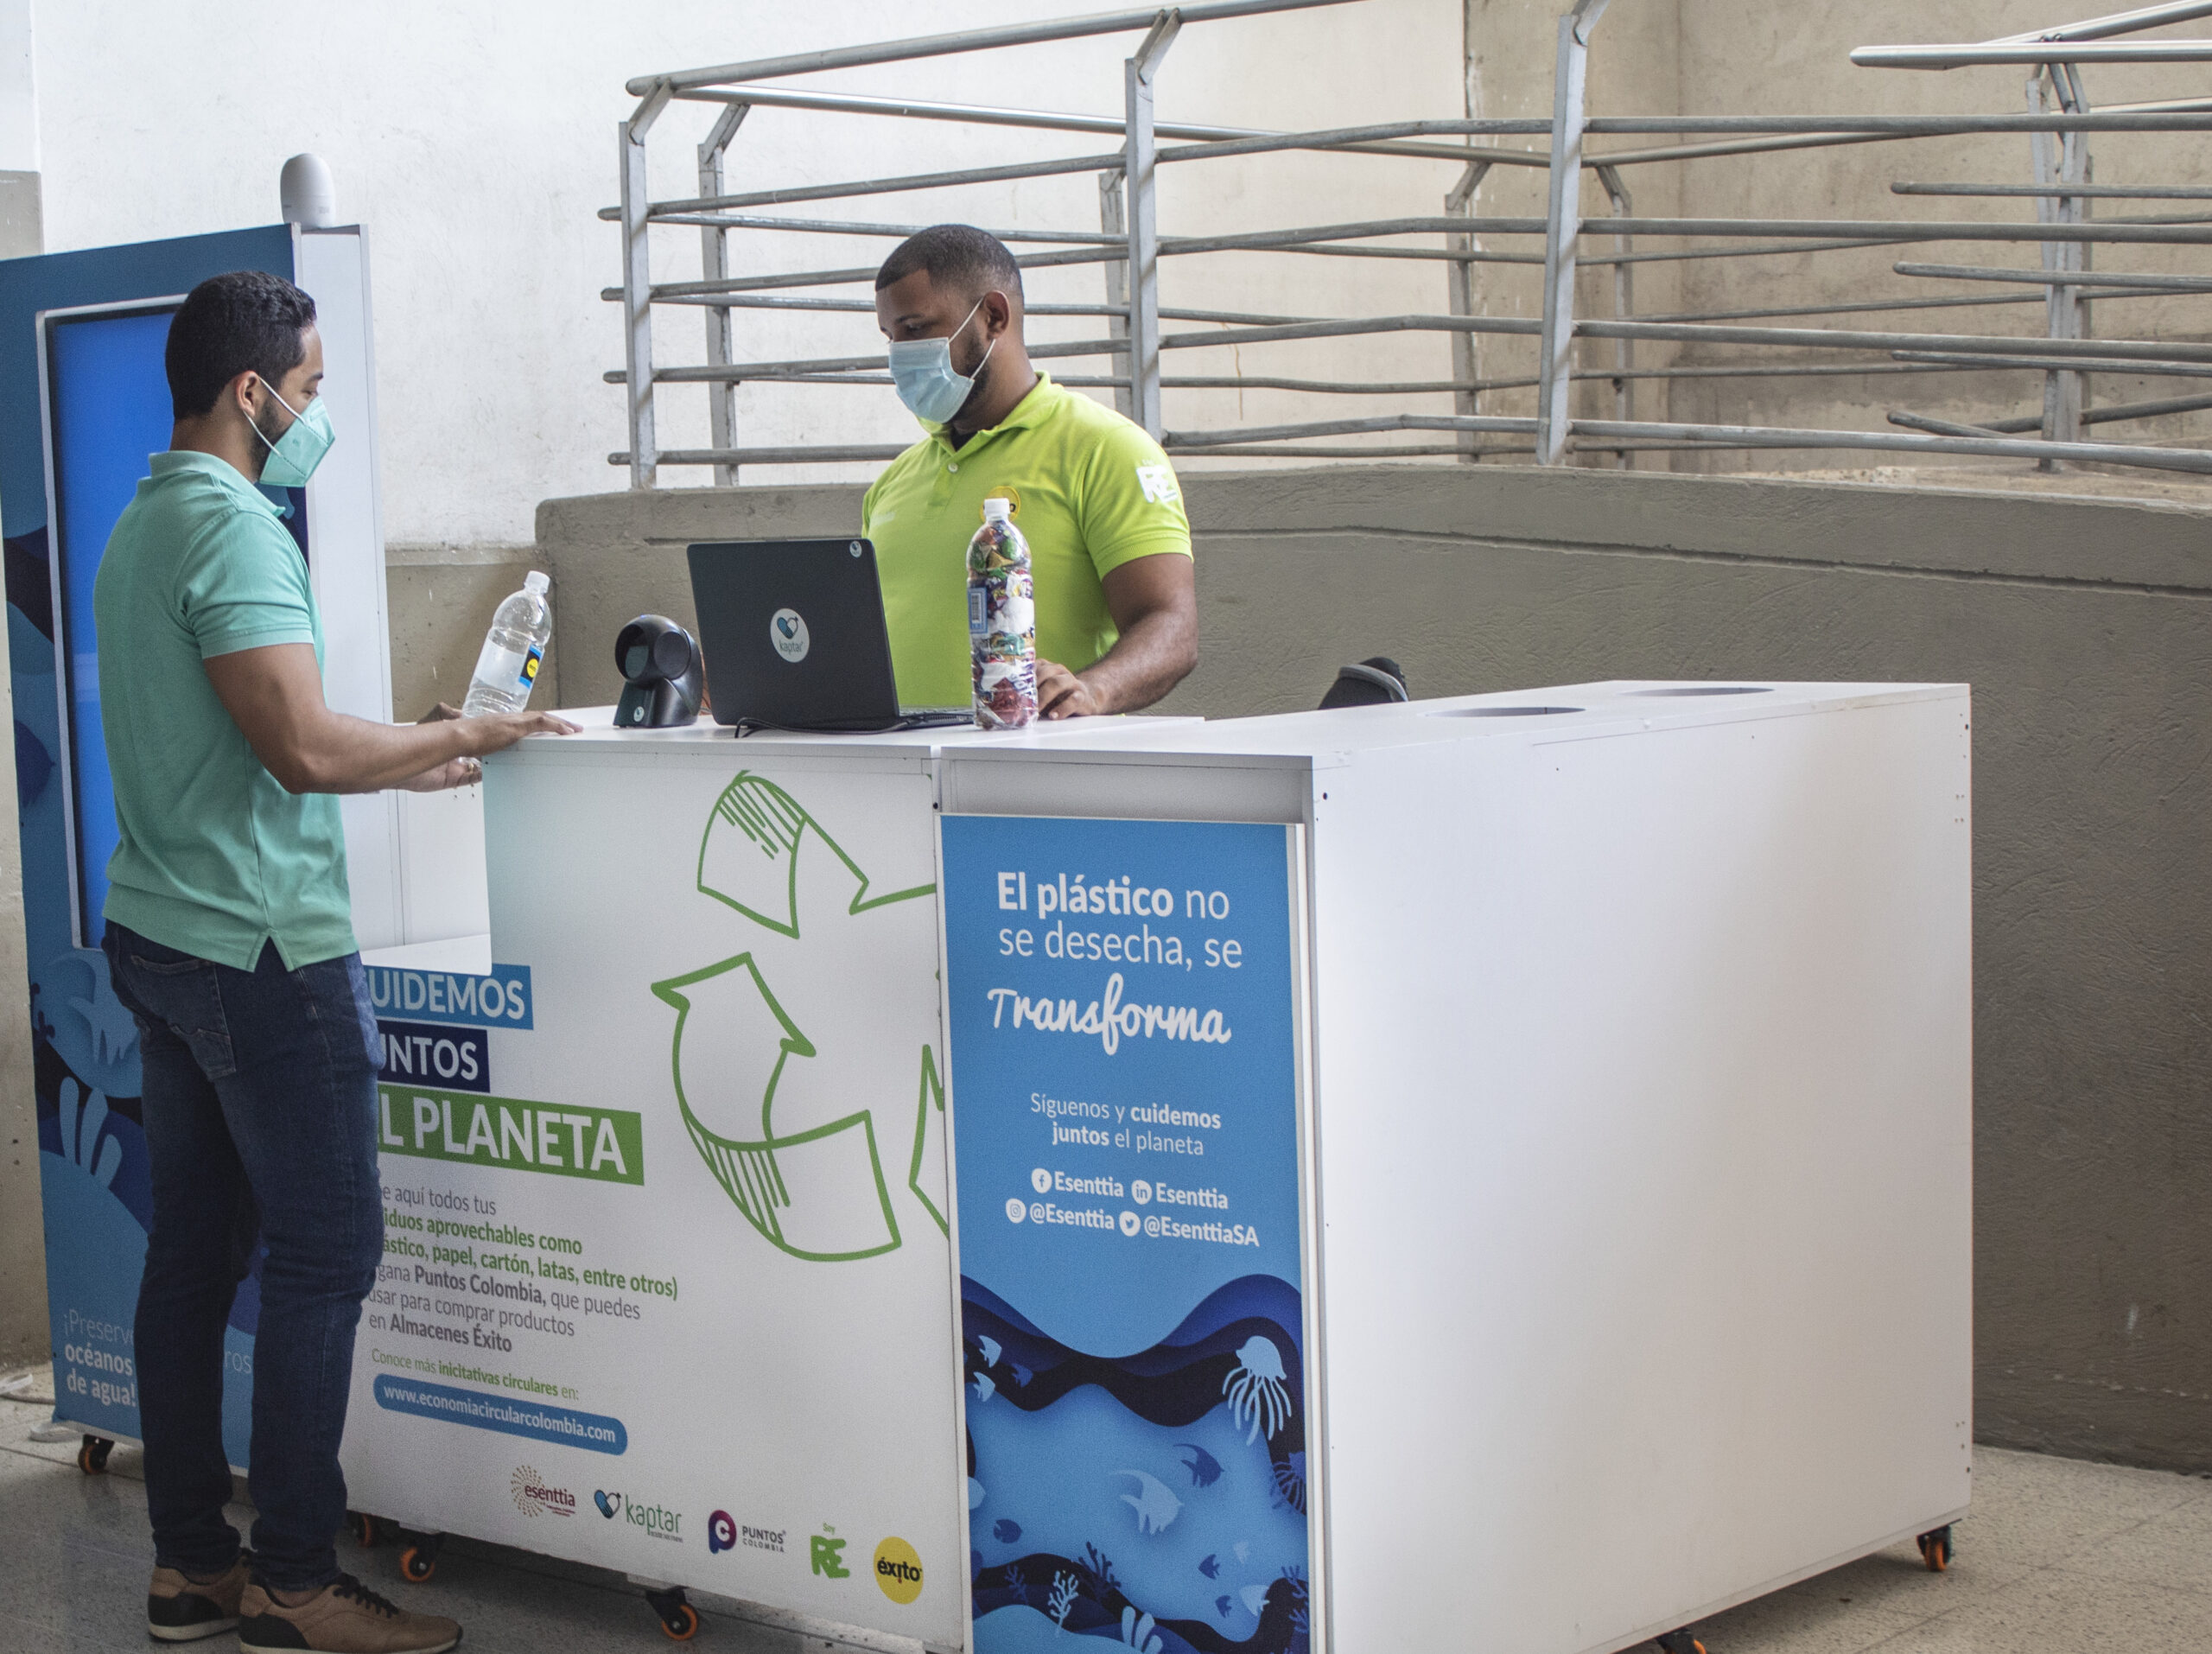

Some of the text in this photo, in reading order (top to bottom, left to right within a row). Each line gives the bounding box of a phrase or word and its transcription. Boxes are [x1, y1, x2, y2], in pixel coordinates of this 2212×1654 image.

[998, 871, 1230, 919] El plástico no
[999, 919, 1243, 971] se desecha, se
[368, 969, 525, 1020] UIDEMOS
[987, 972, 1232, 1055] Transforma
[380, 1033, 479, 1081] NTOS
[1030, 1092, 1222, 1129] Síguenos y cuidemos
[413, 1096, 628, 1175] PLANETA
[1052, 1122, 1204, 1155] juntos el planeta
[428, 1189, 470, 1212] todos
[474, 1198, 497, 1215] tus
[1055, 1171, 1124, 1198] Esenttia
[1156, 1183, 1229, 1210] Esenttia
[383, 1207, 582, 1255] iduos aprovechables como
[1030, 1202, 1260, 1247] @Esenttia @EsenttiaSA
[415, 1264, 467, 1291] Puntos
[470, 1274, 547, 1307] Colombia,
[551, 1290, 579, 1312] que
[584, 1295, 640, 1320] puedes
[433, 1245, 477, 1268] papel,
[480, 1253, 534, 1277] cartón,
[537, 1257, 579, 1285] latas,
[582, 1268, 626, 1290] entre
[630, 1275, 677, 1301] otros)
[368, 1289, 575, 1337] usar para comprar productos
[369, 1313, 512, 1353] en Almacenes Éxito
[65, 1342, 134, 1376] océanos
[372, 1348, 412, 1369] Conoce
[415, 1358, 436, 1375] más
[503, 1373, 559, 1397] circulares
[561, 1386, 579, 1401] en:
[67, 1369, 137, 1408] de agua!
[383, 1385, 616, 1444] www.economiacircularcolombia.com
[524, 1485, 575, 1507] esenttia
[626, 1494, 682, 1536] kaptar
[742, 1526, 784, 1544] PUNTOS
[742, 1538, 785, 1553] COLOMBIA
